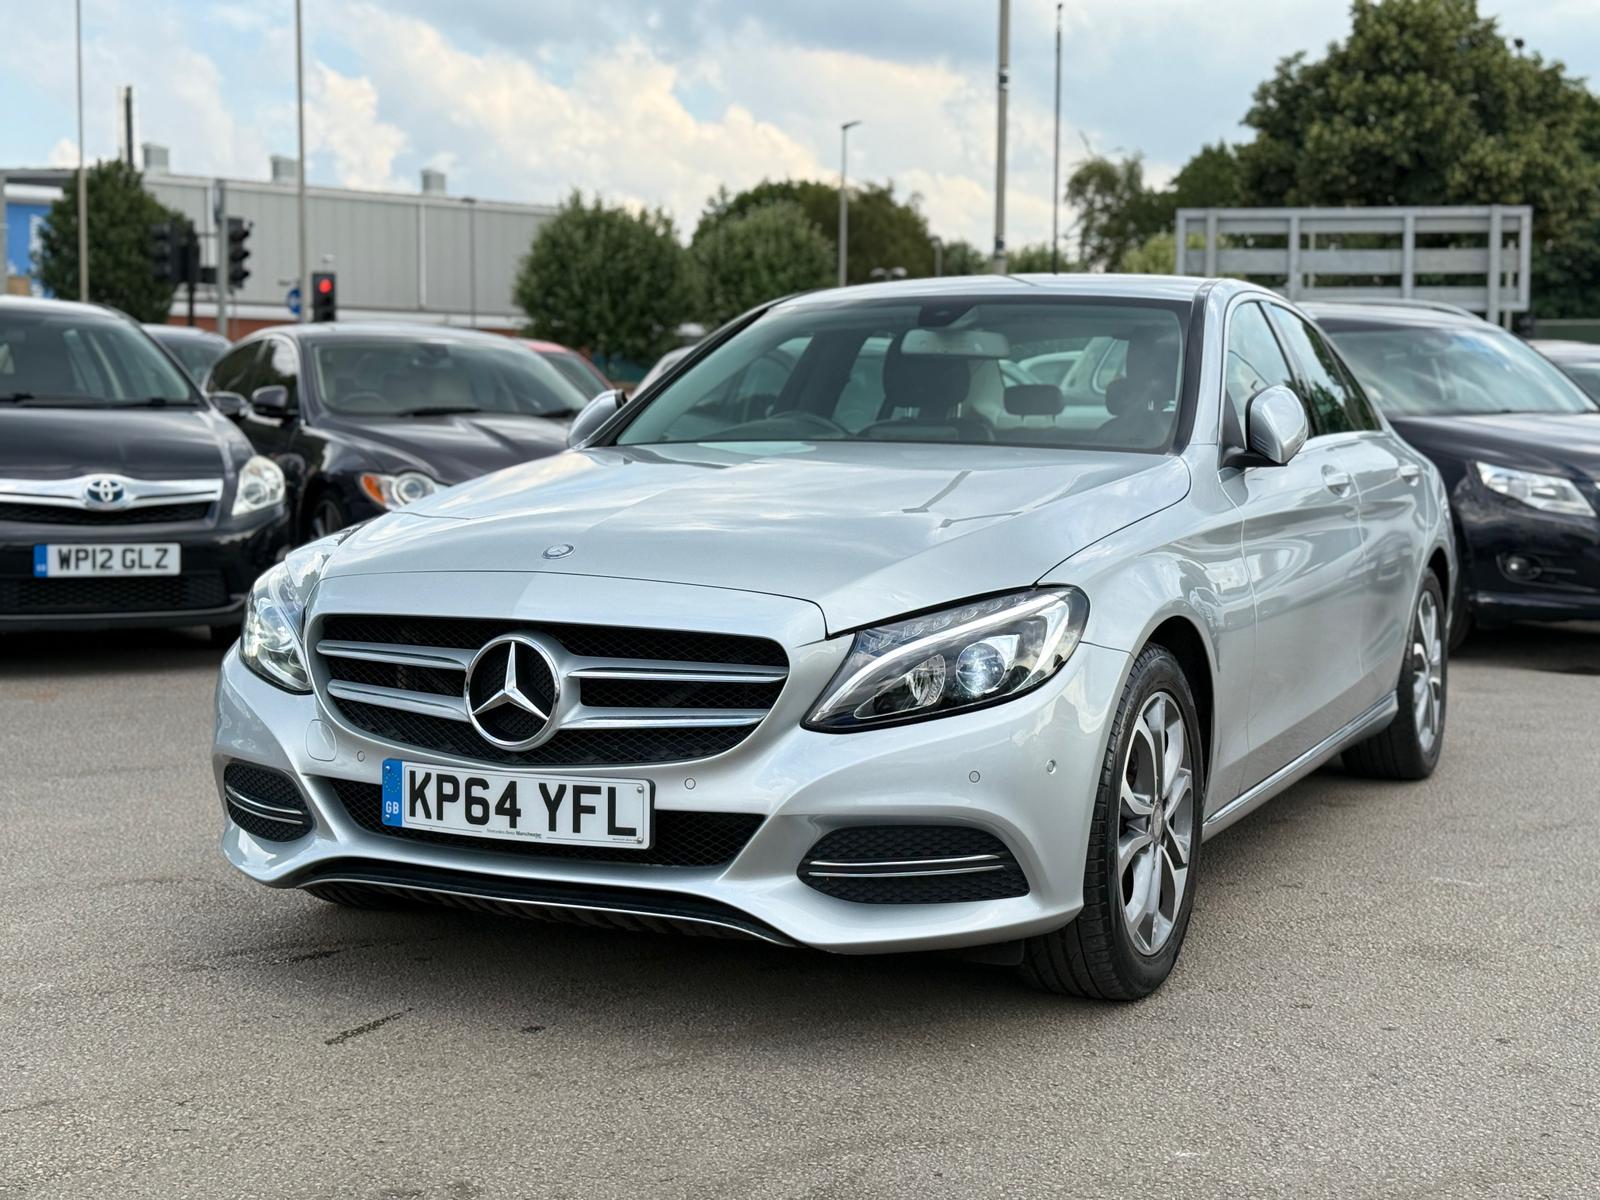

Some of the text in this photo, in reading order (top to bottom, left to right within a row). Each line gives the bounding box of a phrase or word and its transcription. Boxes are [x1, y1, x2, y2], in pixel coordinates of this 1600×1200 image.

[58, 548, 169, 571] WP12 GLZ
[385, 800, 399, 814] GB
[409, 770, 637, 837] KP64 YFL
